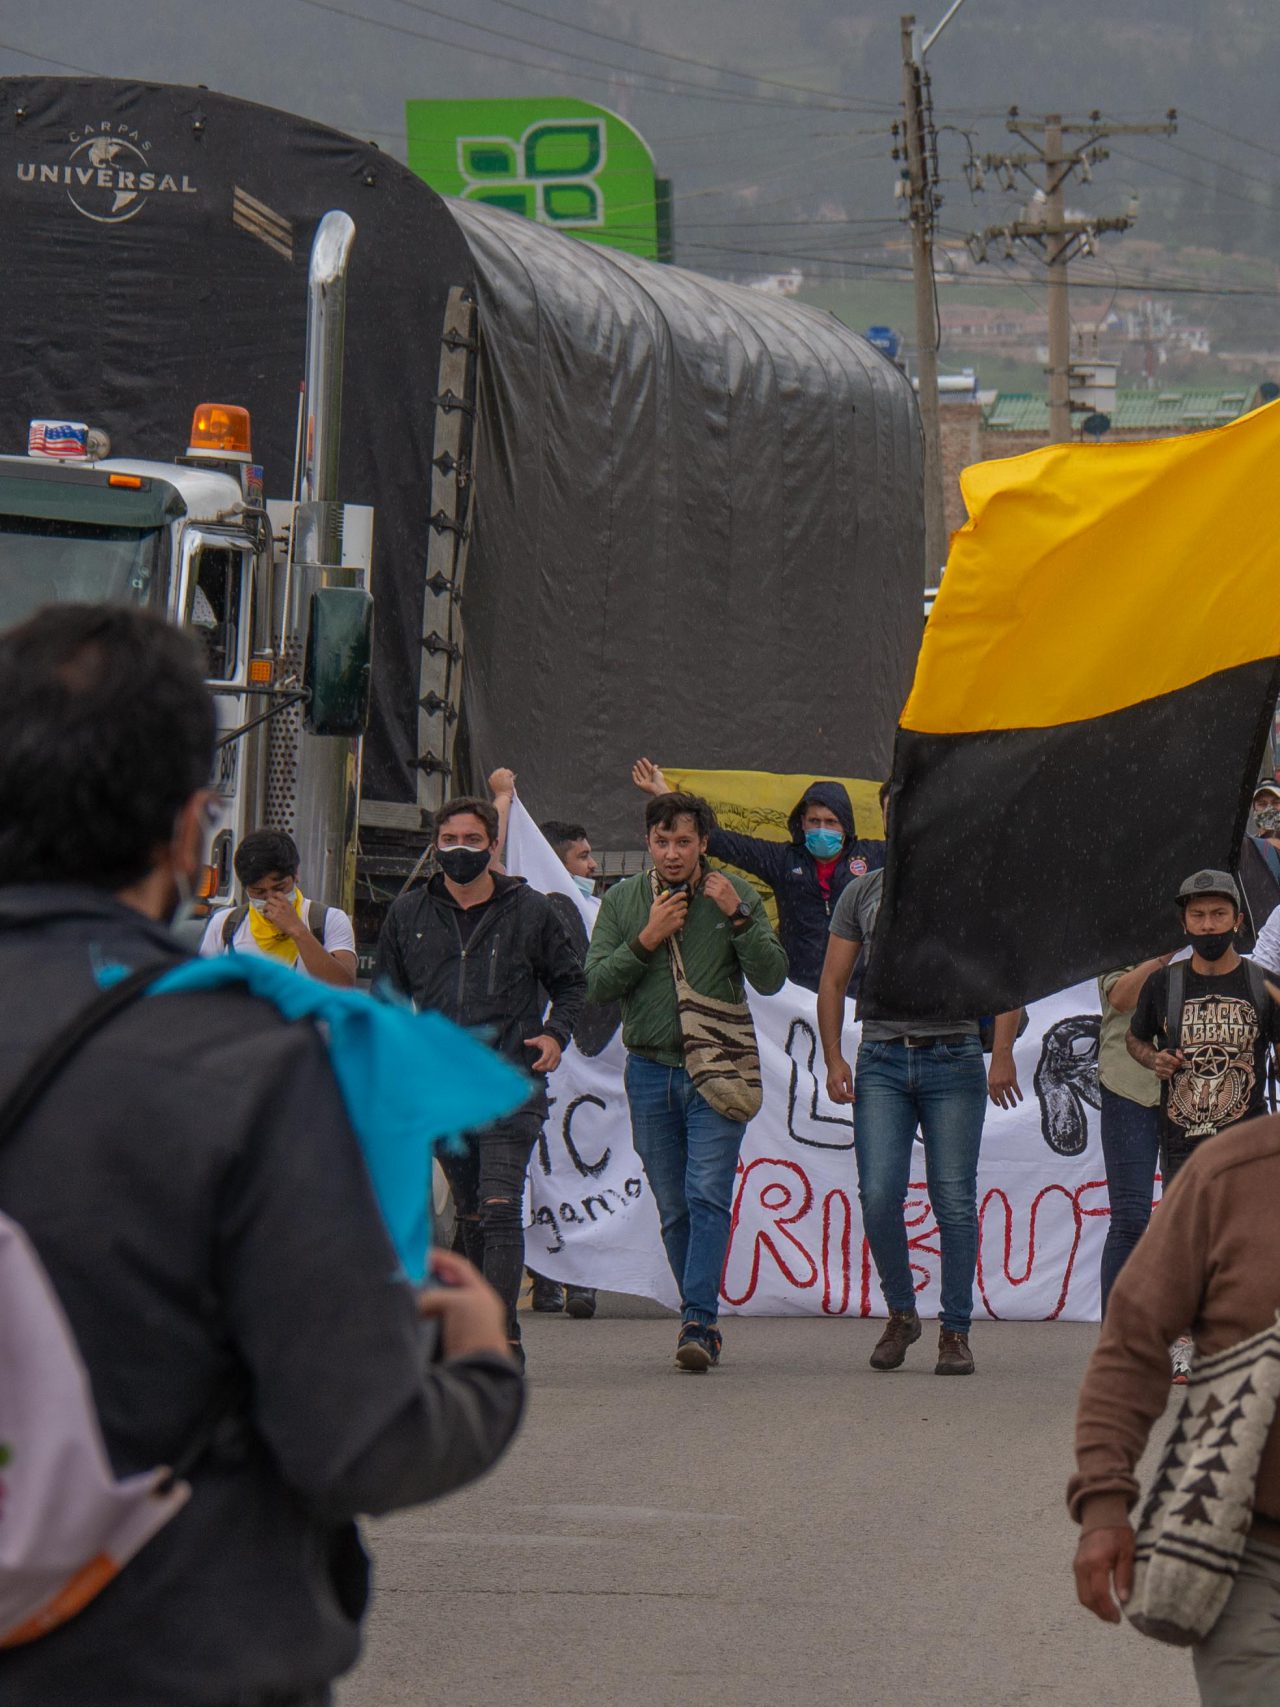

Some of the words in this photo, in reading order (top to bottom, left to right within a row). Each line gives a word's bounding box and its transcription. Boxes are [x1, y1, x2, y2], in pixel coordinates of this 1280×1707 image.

[68, 121, 152, 150] CARPAS
[17, 163, 197, 193] UNIVERSAL
[1182, 1002, 1244, 1025] BLACK
[1181, 1023, 1260, 1046] ABBATH
[1190, 1122, 1214, 1130] BLACK
